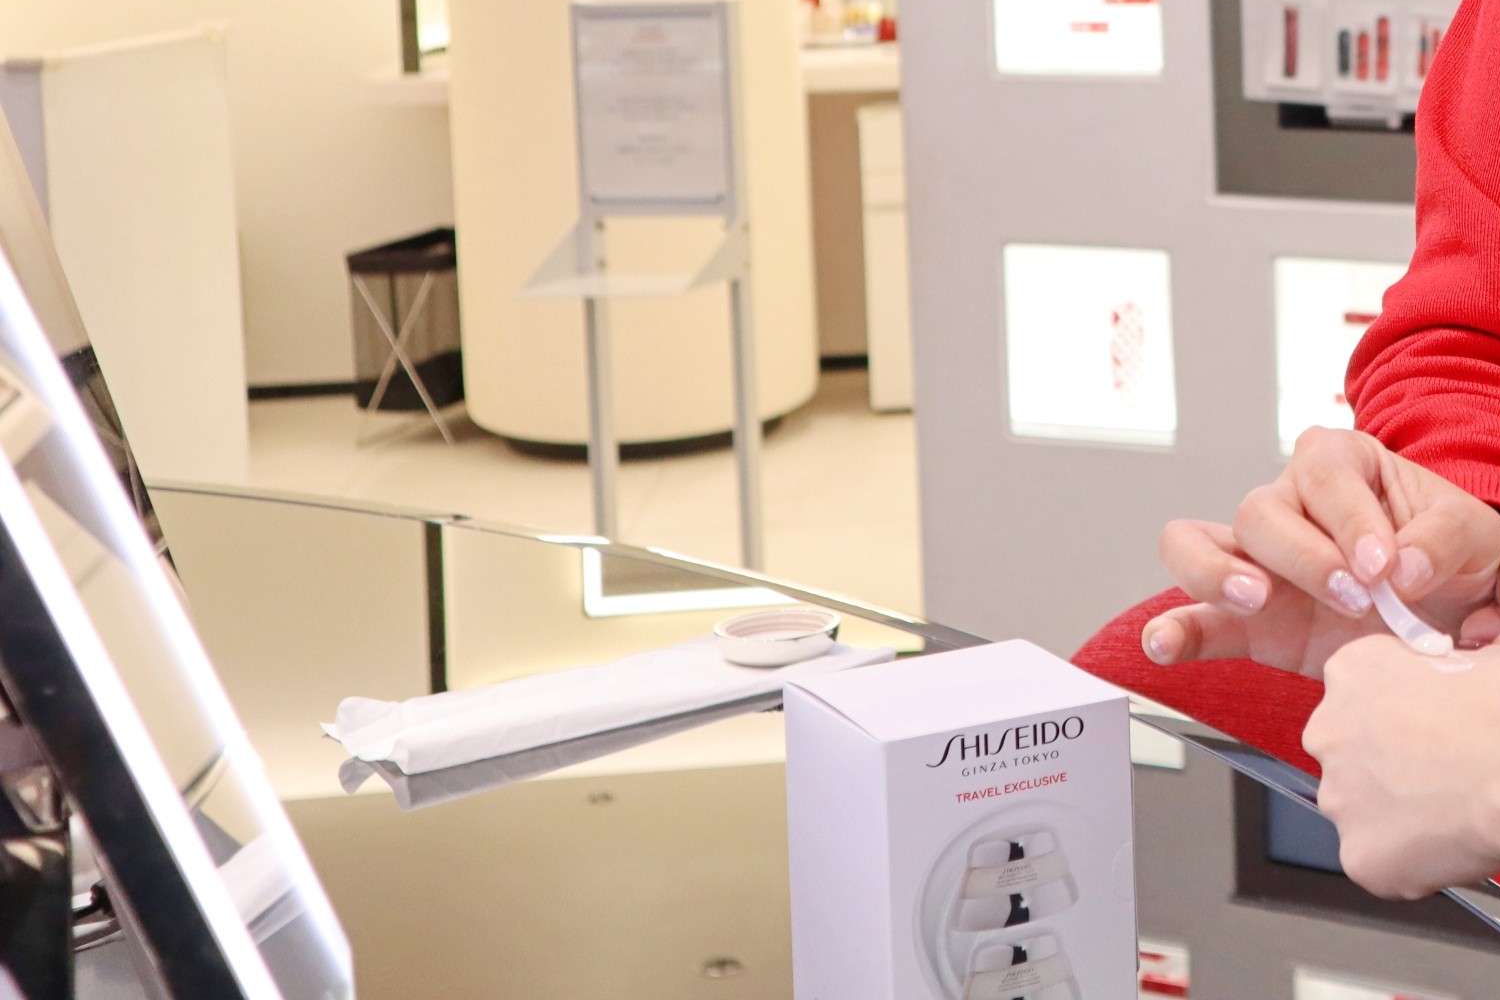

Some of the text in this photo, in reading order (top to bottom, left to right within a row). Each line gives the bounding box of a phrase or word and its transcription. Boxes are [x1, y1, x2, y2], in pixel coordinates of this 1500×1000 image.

[926, 715, 1085, 769] SHISEIDO
[961, 750, 1060, 778] GINZA TOKYO
[955, 772, 1067, 804] TRAVEL EXCLUSIVE
